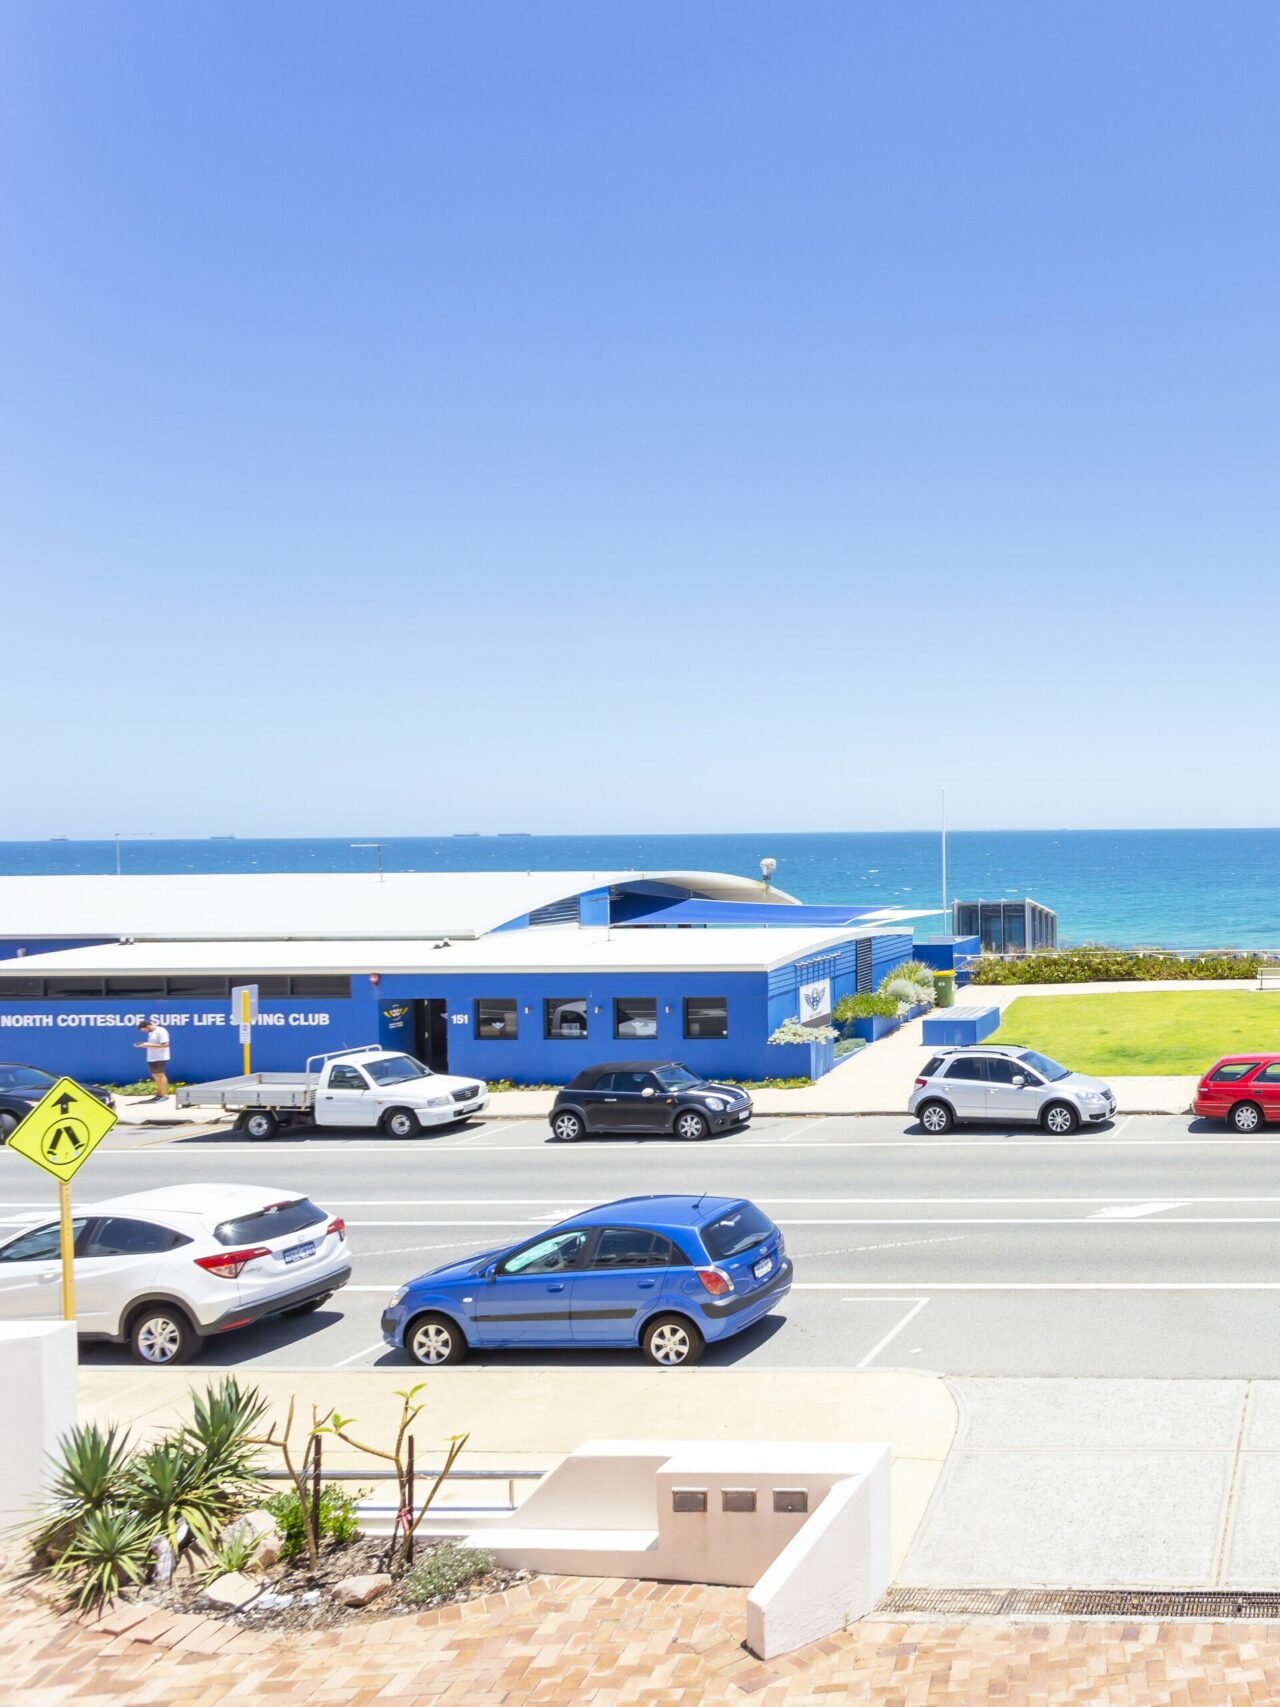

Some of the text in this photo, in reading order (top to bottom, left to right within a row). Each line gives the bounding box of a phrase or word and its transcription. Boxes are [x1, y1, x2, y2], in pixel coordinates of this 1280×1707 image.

[1, 1014, 53, 1027] NORTH
[150, 1014, 189, 1026] SURF
[193, 1013, 225, 1025] LIFE
[288, 1013, 330, 1026] CLUB
[451, 1014, 469, 1025] 151
